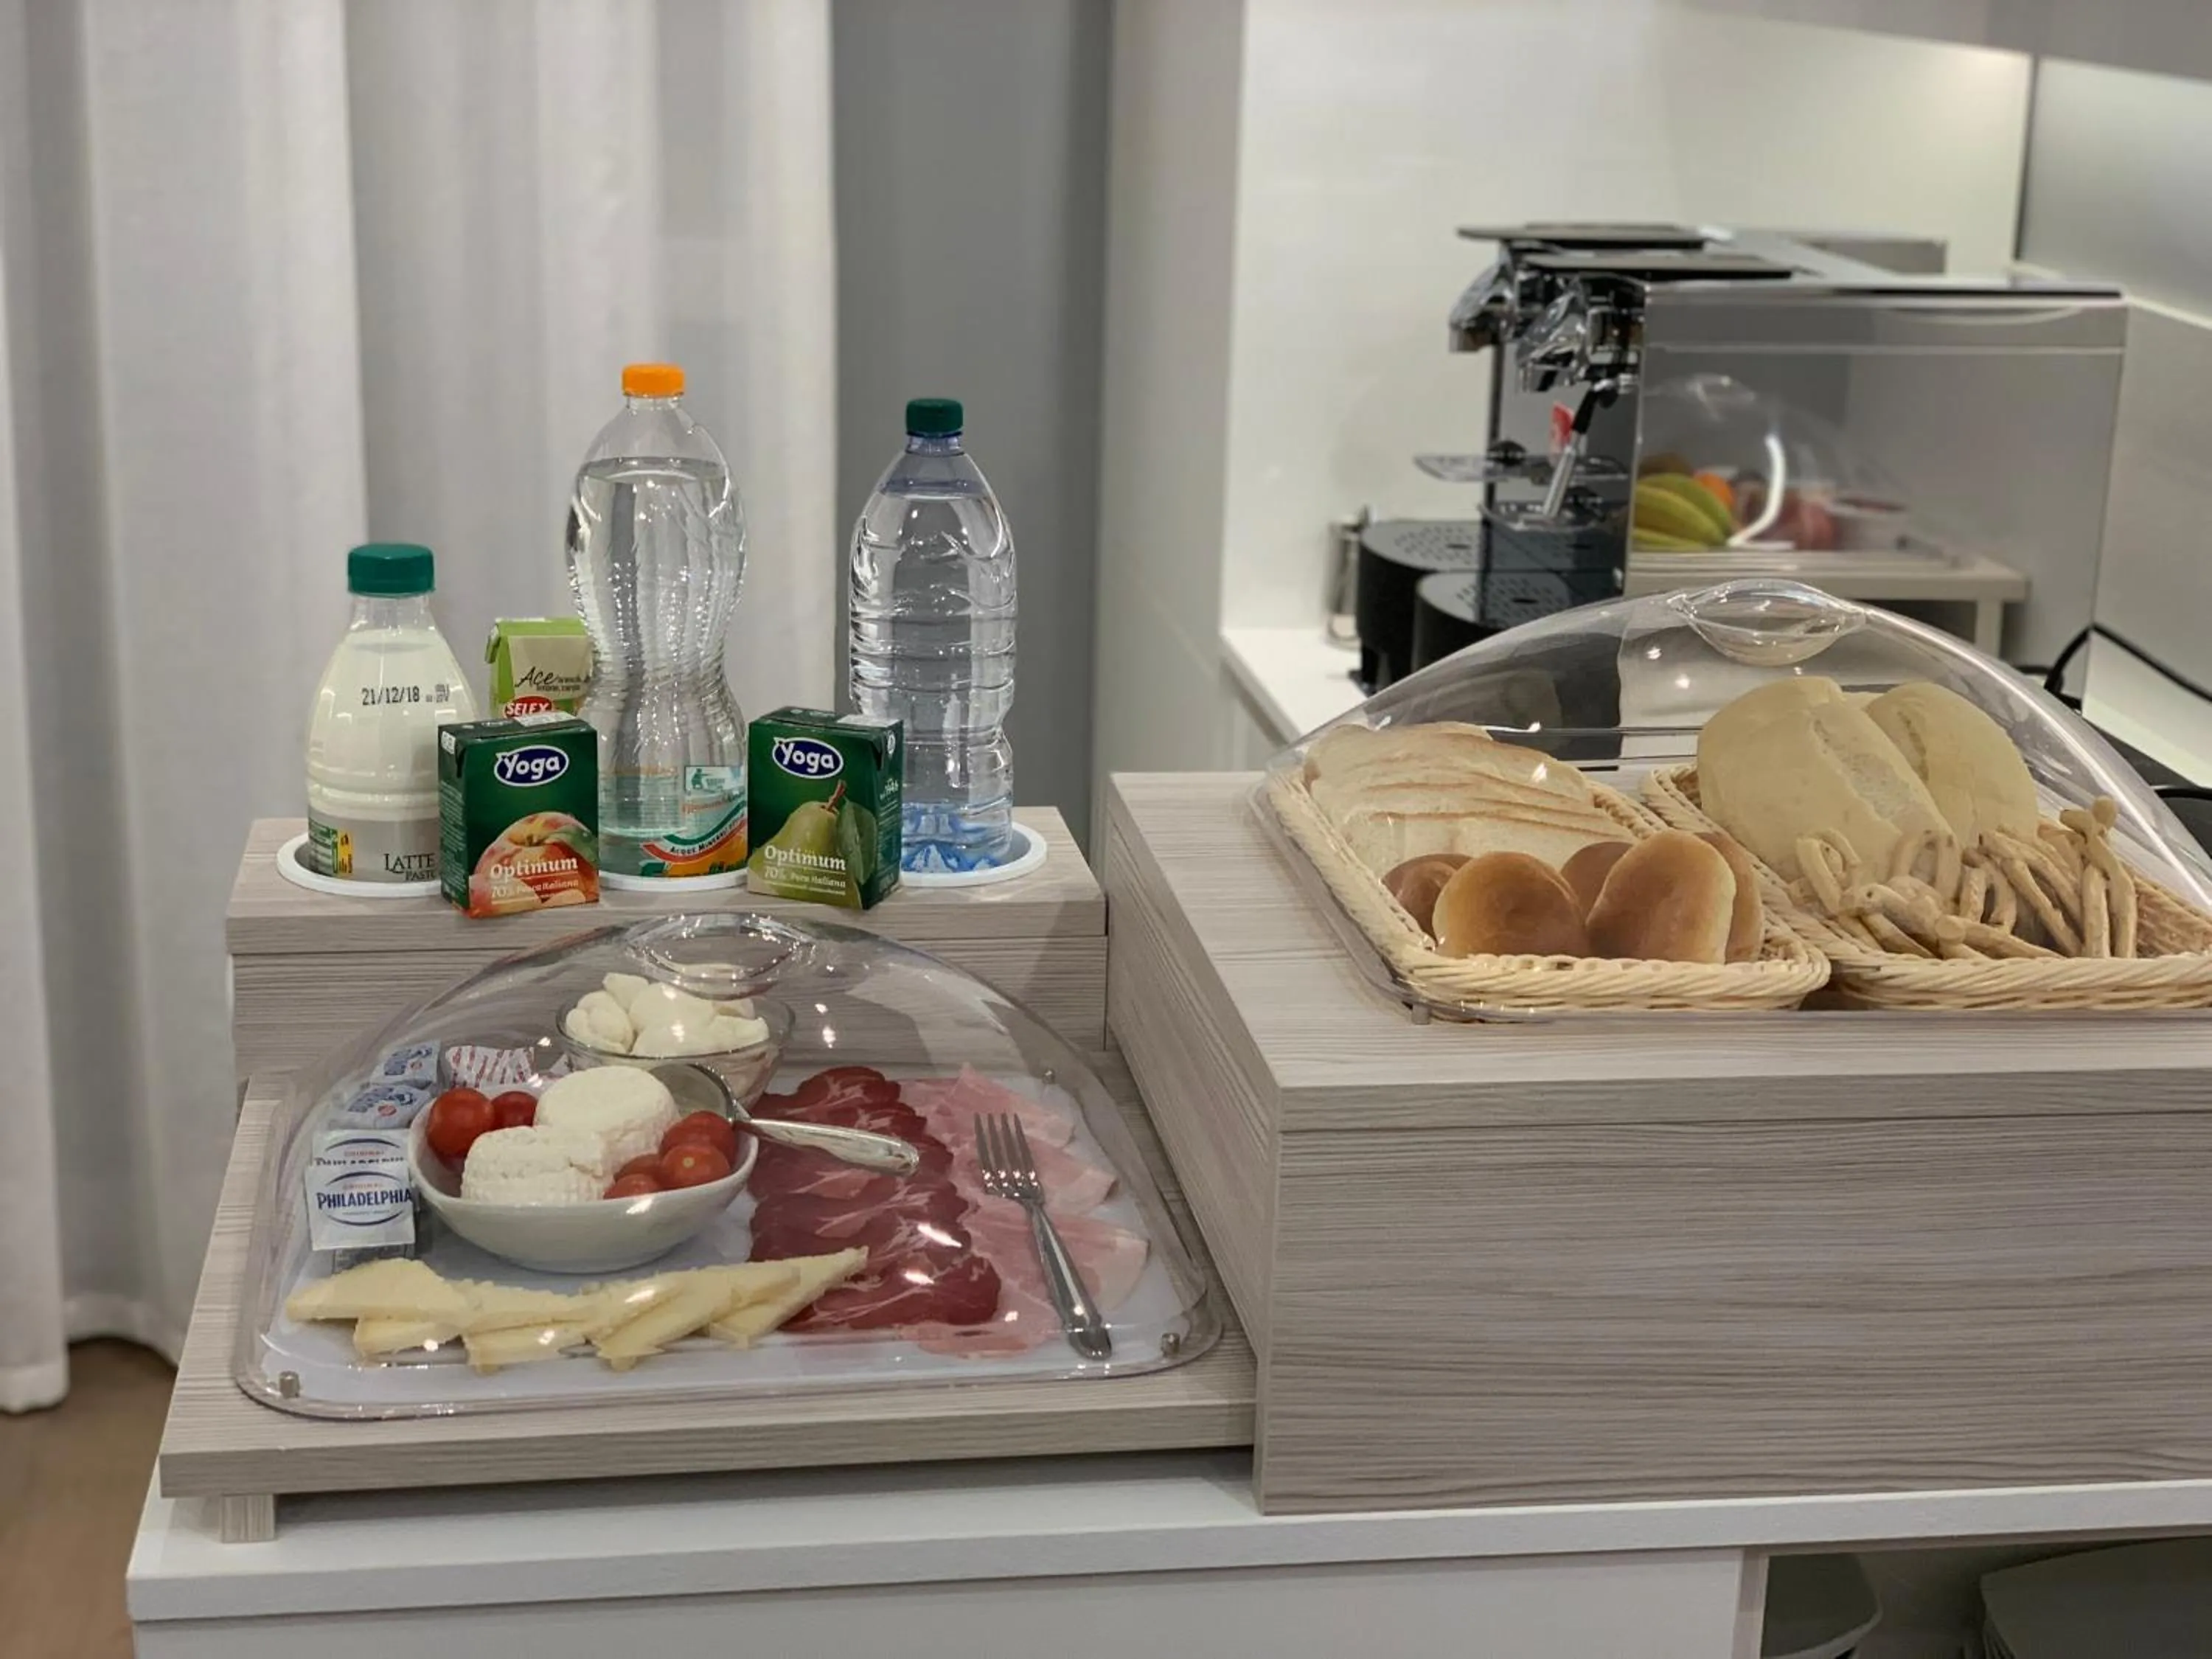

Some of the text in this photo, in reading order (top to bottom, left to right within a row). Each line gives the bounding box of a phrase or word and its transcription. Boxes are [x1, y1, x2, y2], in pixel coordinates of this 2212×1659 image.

[515, 666, 554, 687] Ace
[362, 685, 420, 706] 21/12/18
[504, 753, 560, 781] Yoga
[780, 742, 835, 773] Yoga
[383, 852, 436, 874] LATTE
[490, 857, 579, 883] Optimum
[765, 845, 846, 871] Optimum
[316, 1189, 413, 1210] PHILADELPHIA
